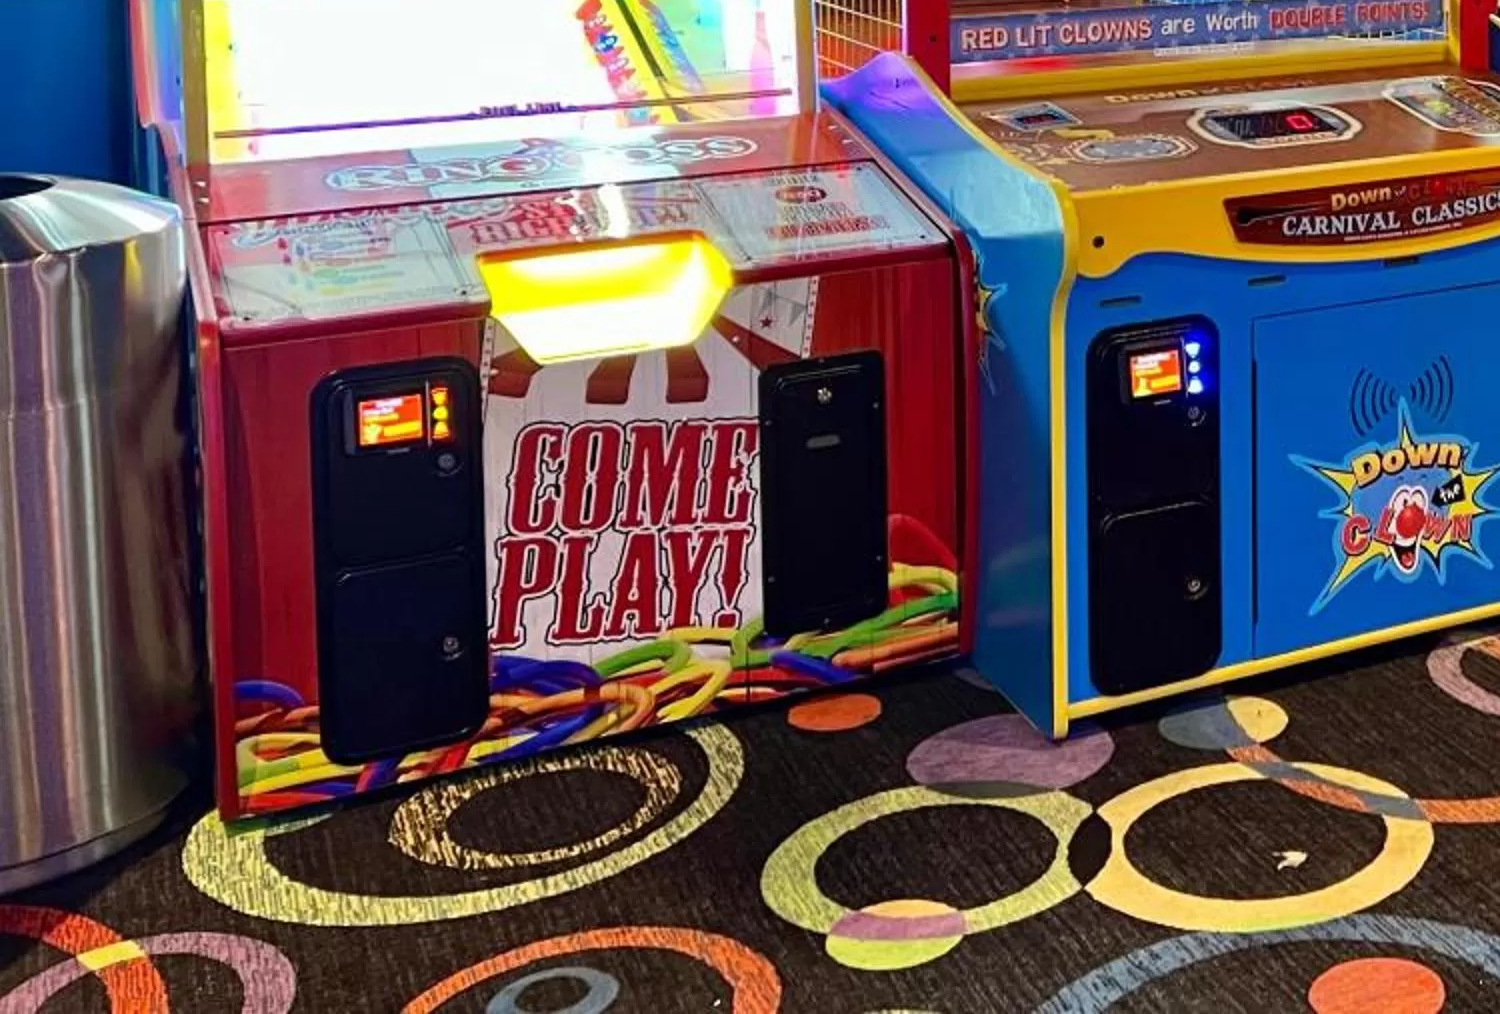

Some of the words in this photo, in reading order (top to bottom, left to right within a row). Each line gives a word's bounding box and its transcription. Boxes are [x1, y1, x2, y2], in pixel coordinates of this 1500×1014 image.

[961, 25, 1008, 50] RED
[1015, 23, 1054, 47] LIT
[1059, 18, 1152, 44] CLOWNS
[1161, 16, 1196, 35] are
[1205, 11, 1259, 33] Worth
[1269, 6, 1346, 30] DOUBLE
[1331, 189, 1392, 211] Down
[1282, 210, 1401, 237] CARNIVAL
[508, 420, 760, 535] COME
[1352, 442, 1462, 487] Down
[1438, 483, 1462, 503] the
[488, 530, 753, 650] PLAY!
